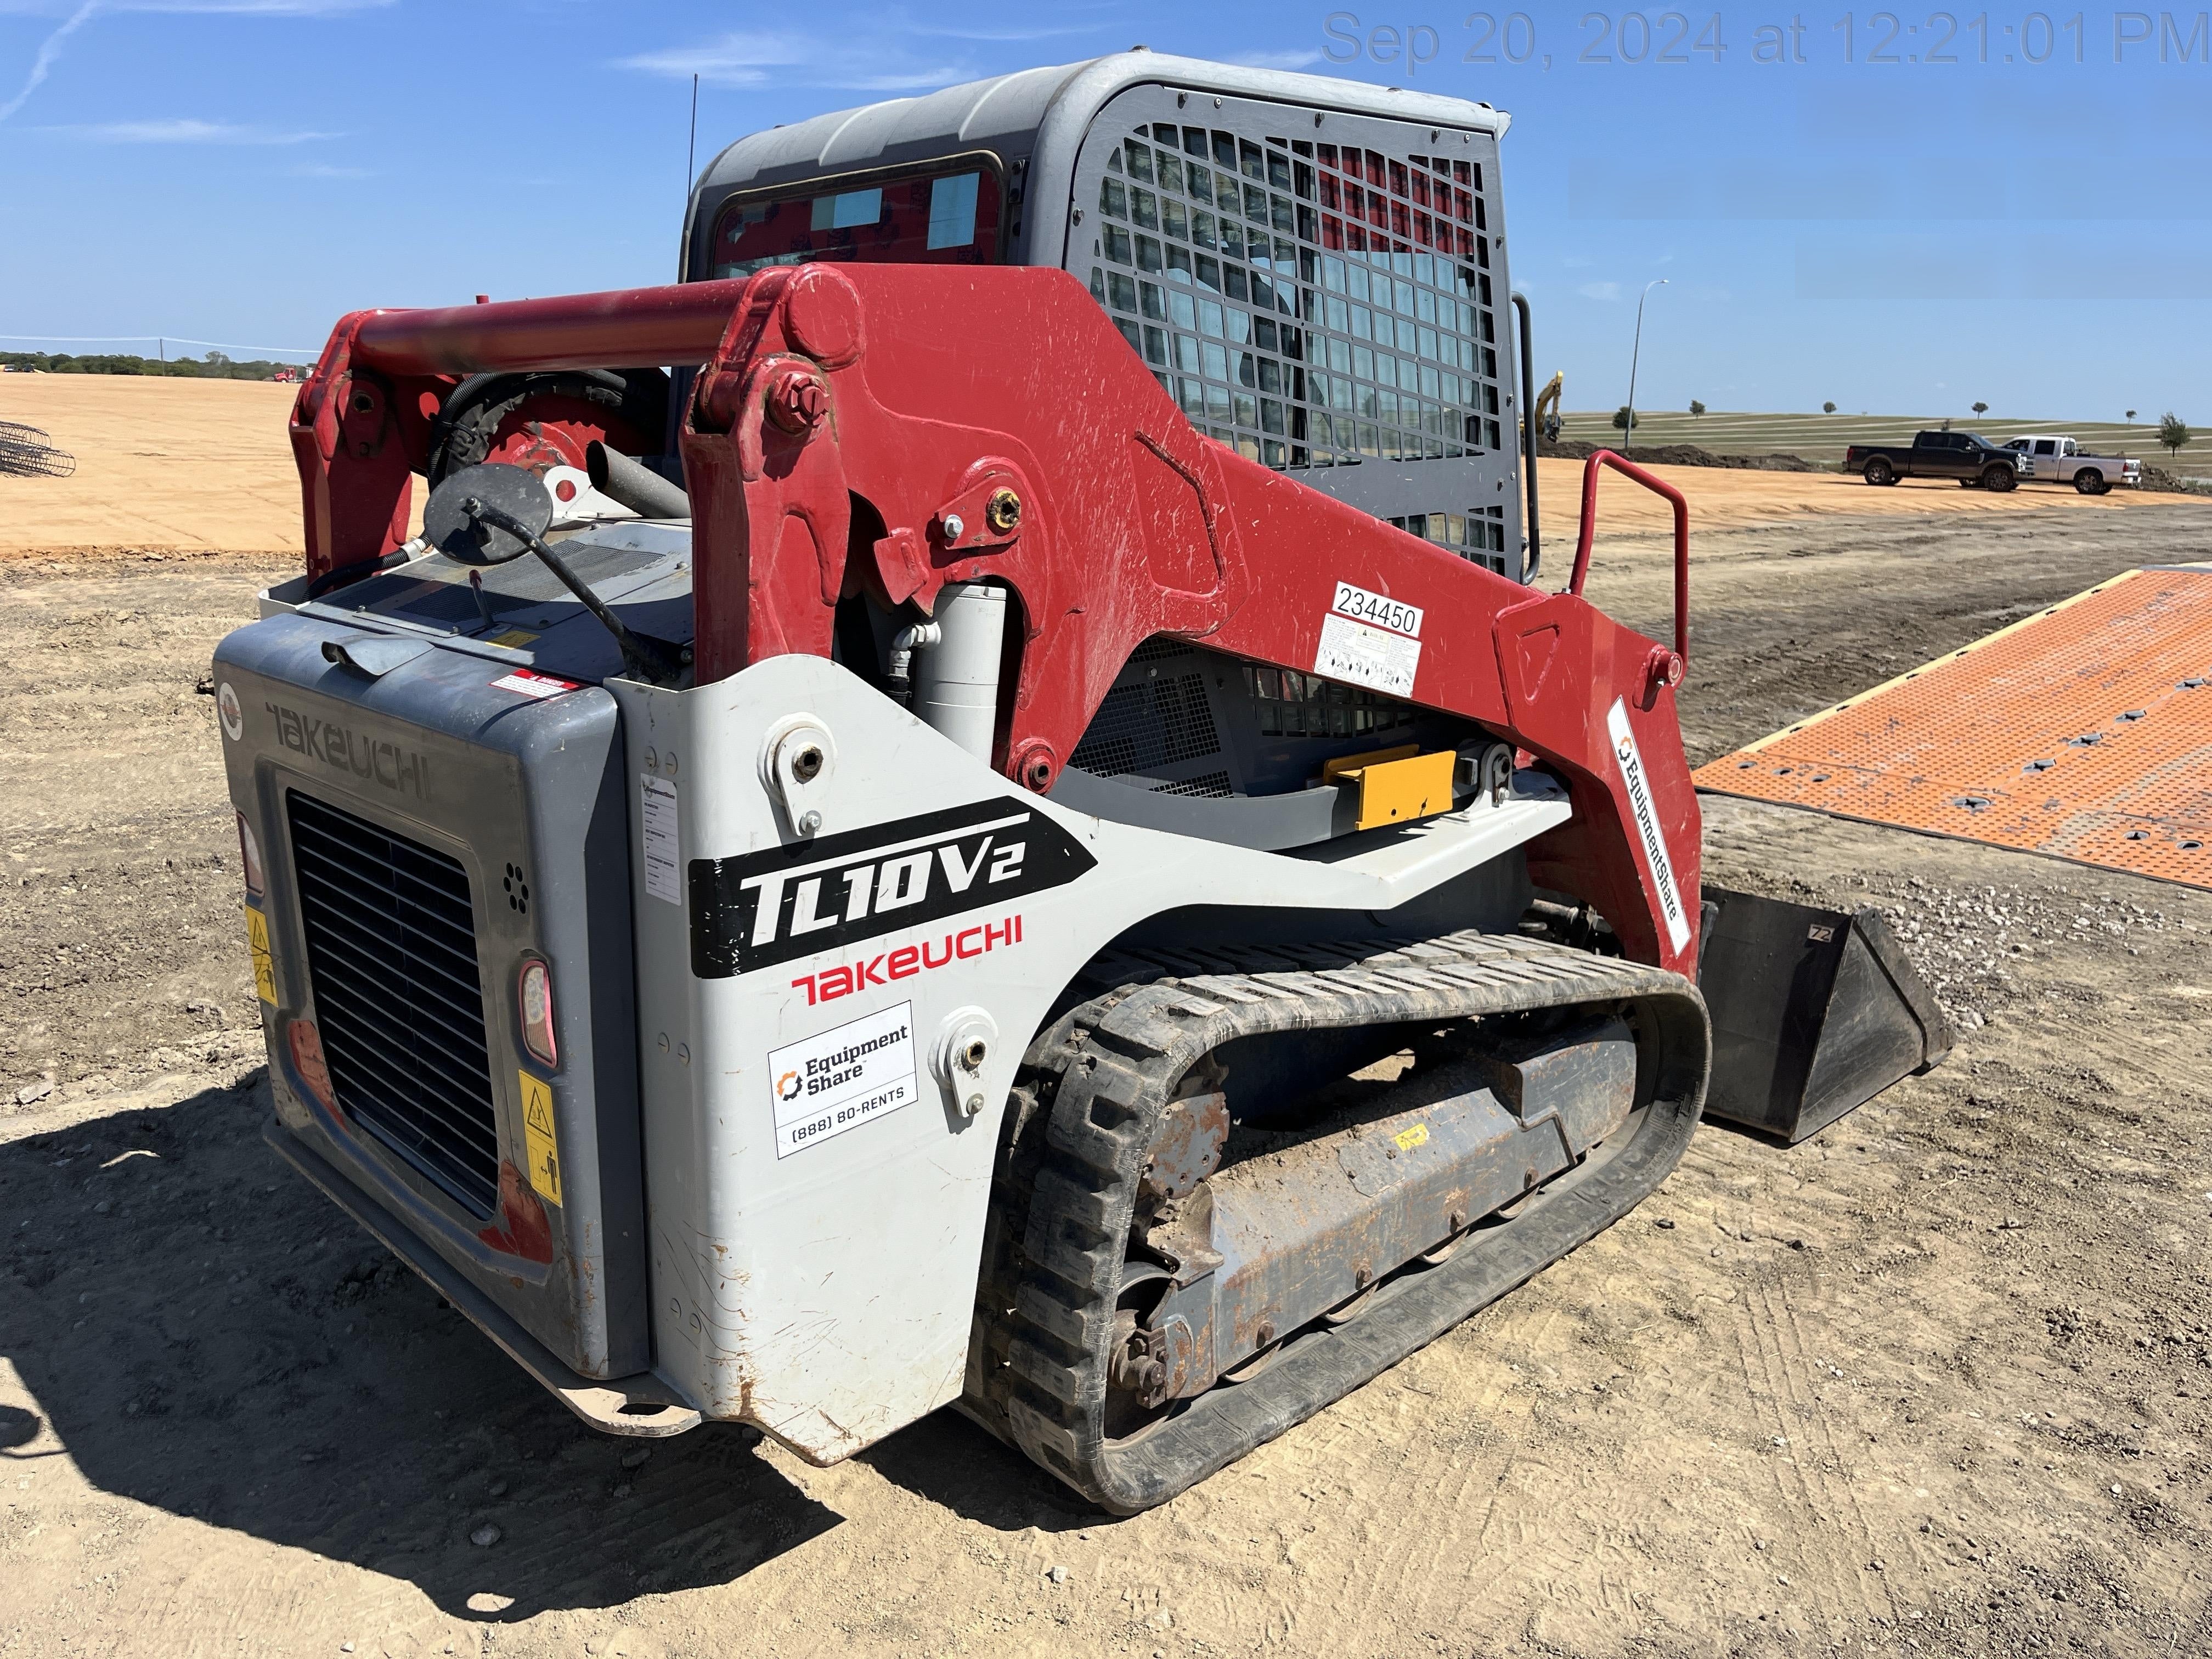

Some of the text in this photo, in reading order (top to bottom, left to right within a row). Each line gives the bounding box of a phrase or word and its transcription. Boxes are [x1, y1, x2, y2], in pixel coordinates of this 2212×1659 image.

[1337, 588, 1415, 633] 234450
[1626, 757, 1676, 921] EquipmentShare
[1812, 926, 1831, 941] 72
[791, 914, 1023, 1007] TAKEUCHI
[805, 1025, 908, 1077] Equipment
[807, 1064, 864, 1096] Share
[792, 1086, 905, 1143] (888) 80-RENTS
